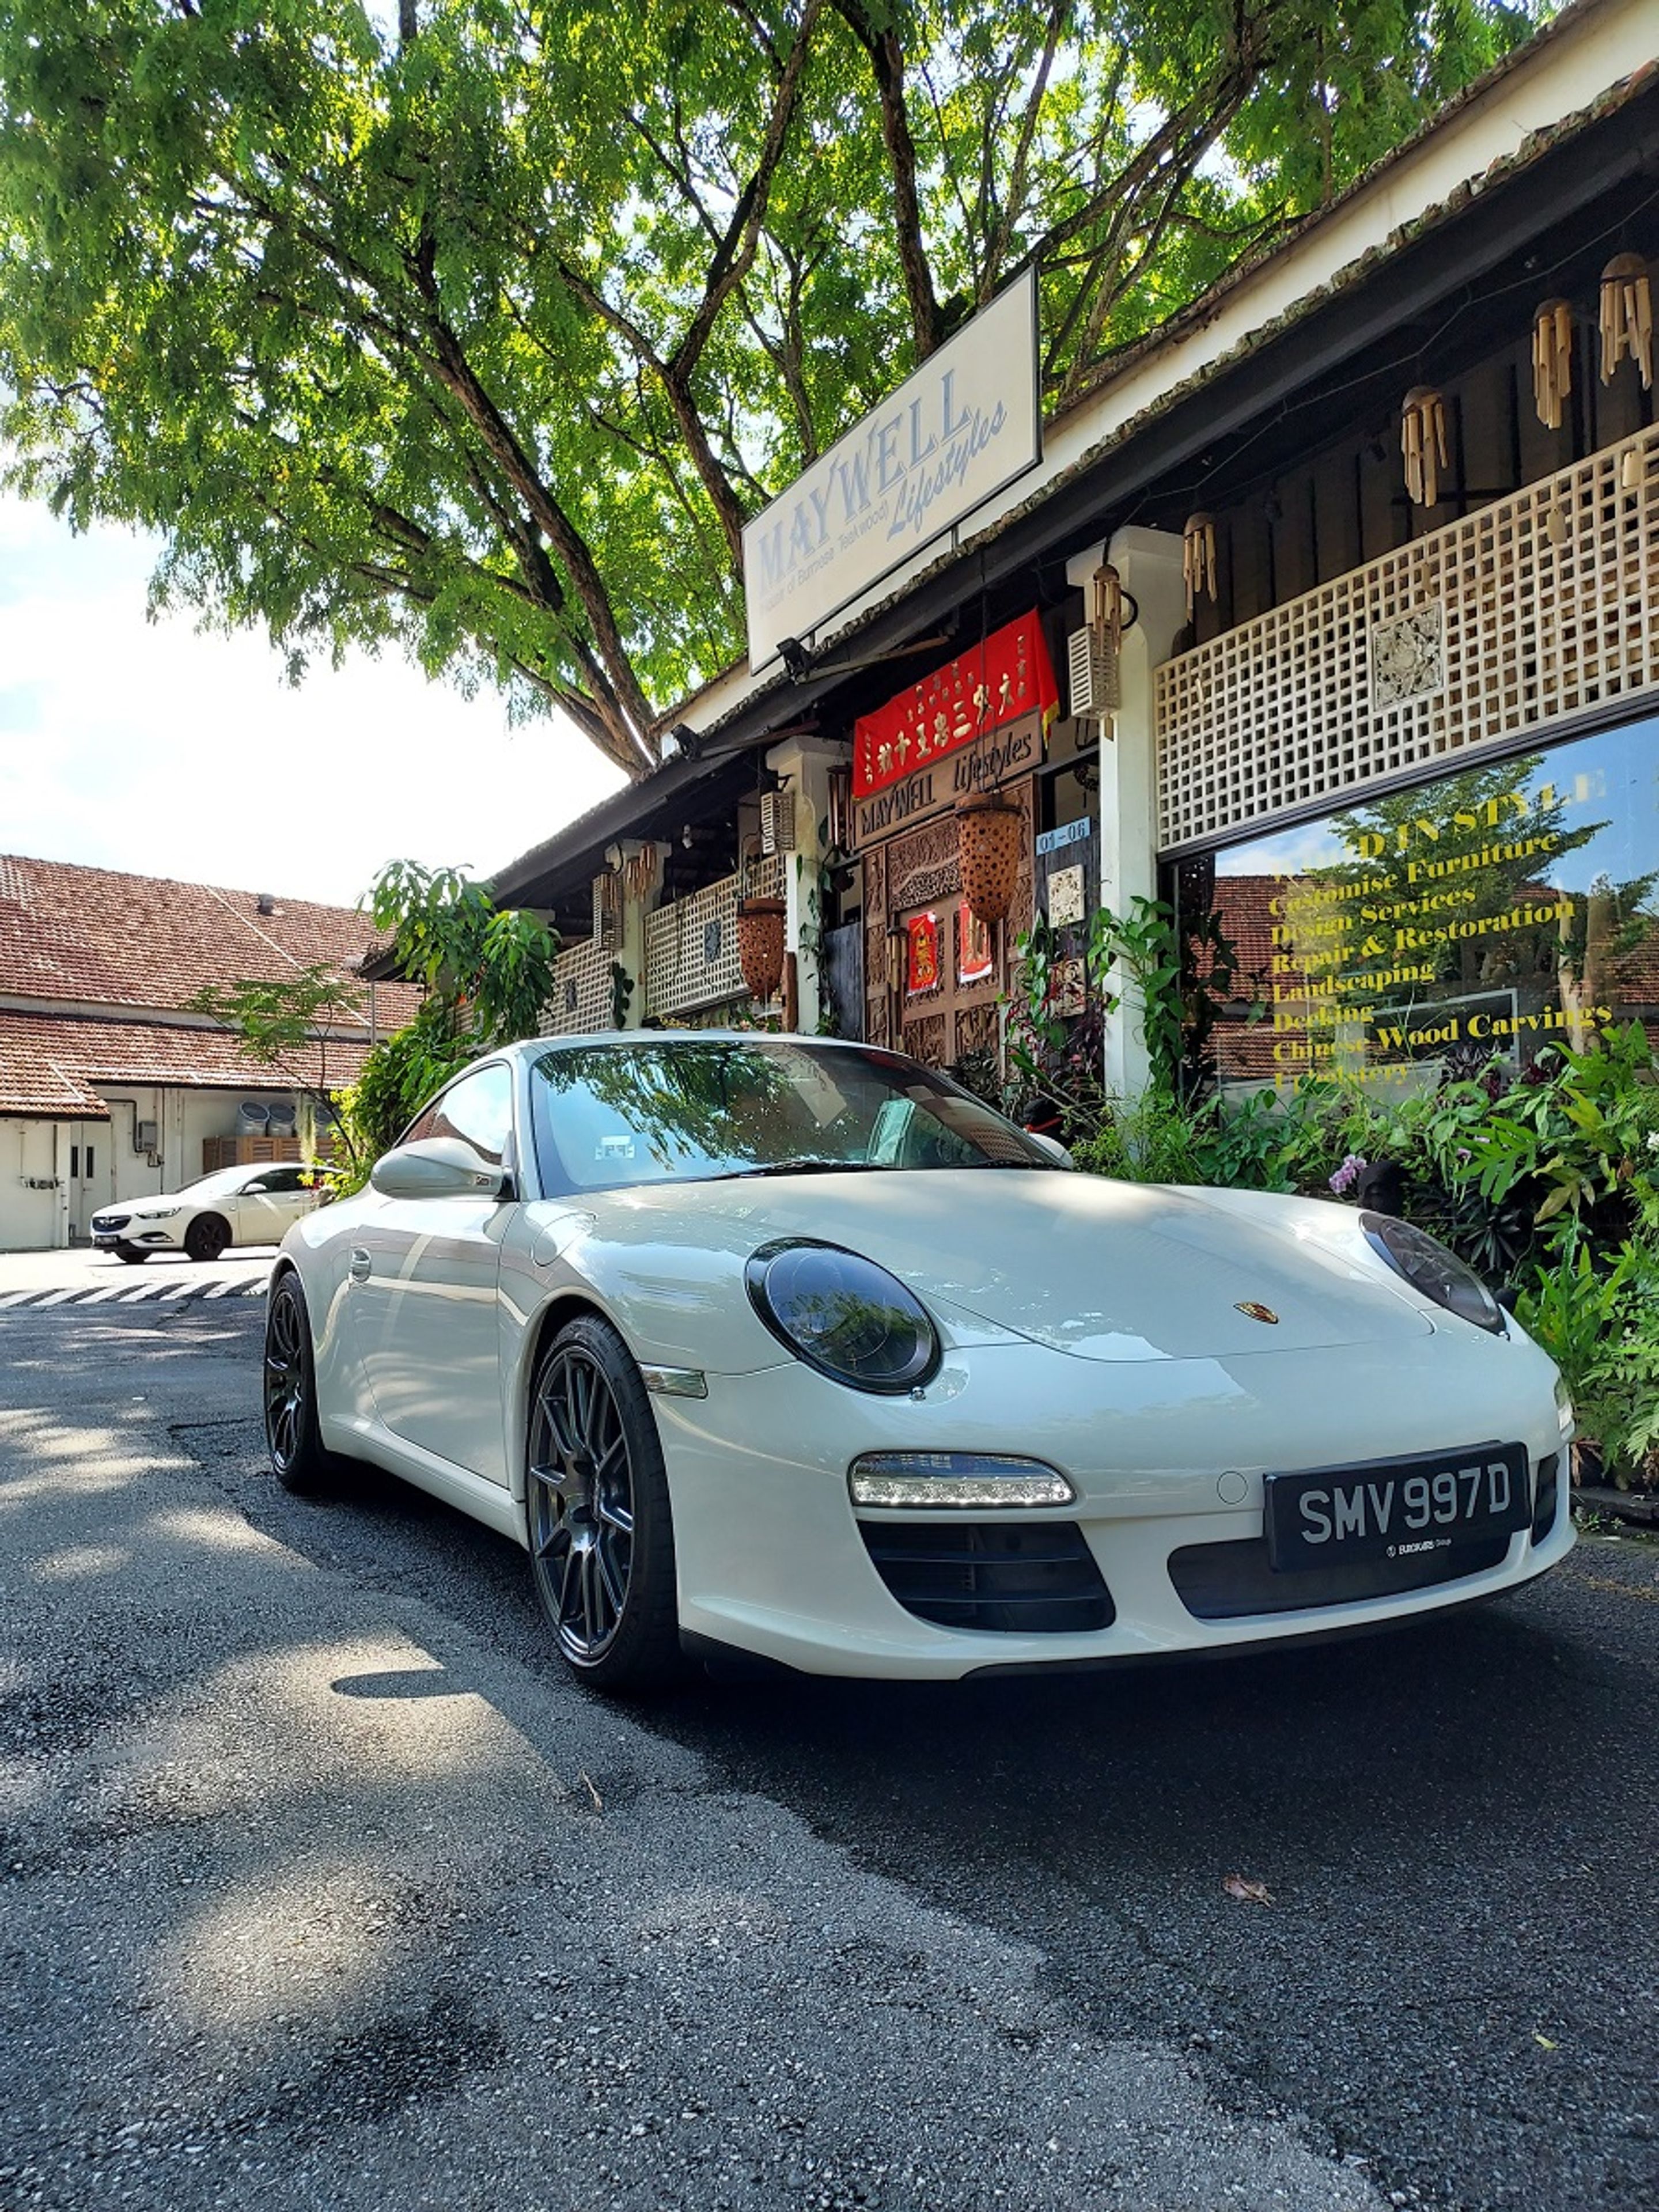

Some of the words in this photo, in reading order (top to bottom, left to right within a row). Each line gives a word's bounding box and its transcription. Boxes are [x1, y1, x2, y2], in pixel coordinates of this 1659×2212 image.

[756, 369, 972, 599] MAYWELL
[887, 400, 1007, 543] Lifestyles
[861, 774, 937, 838] MAYWELL
[1040, 821, 1085, 853] 01-06
[1269, 873, 1399, 916] Customise
[1407, 832, 1558, 884] Furniture
[1271, 915, 1353, 945] Design
[1360, 886, 1477, 926] Services
[1271, 943, 1354, 975] Repair
[1362, 934, 1387, 957] &
[1396, 900, 1575, 950] Restoration
[1273, 961, 1437, 1004] Landscaping
[1273, 1004, 1375, 1033] Decking
[1273, 1037, 1370, 1062] Chinese
[1377, 1018, 1460, 1050] Wood
[1467, 1005, 1612, 1038] Carvings
